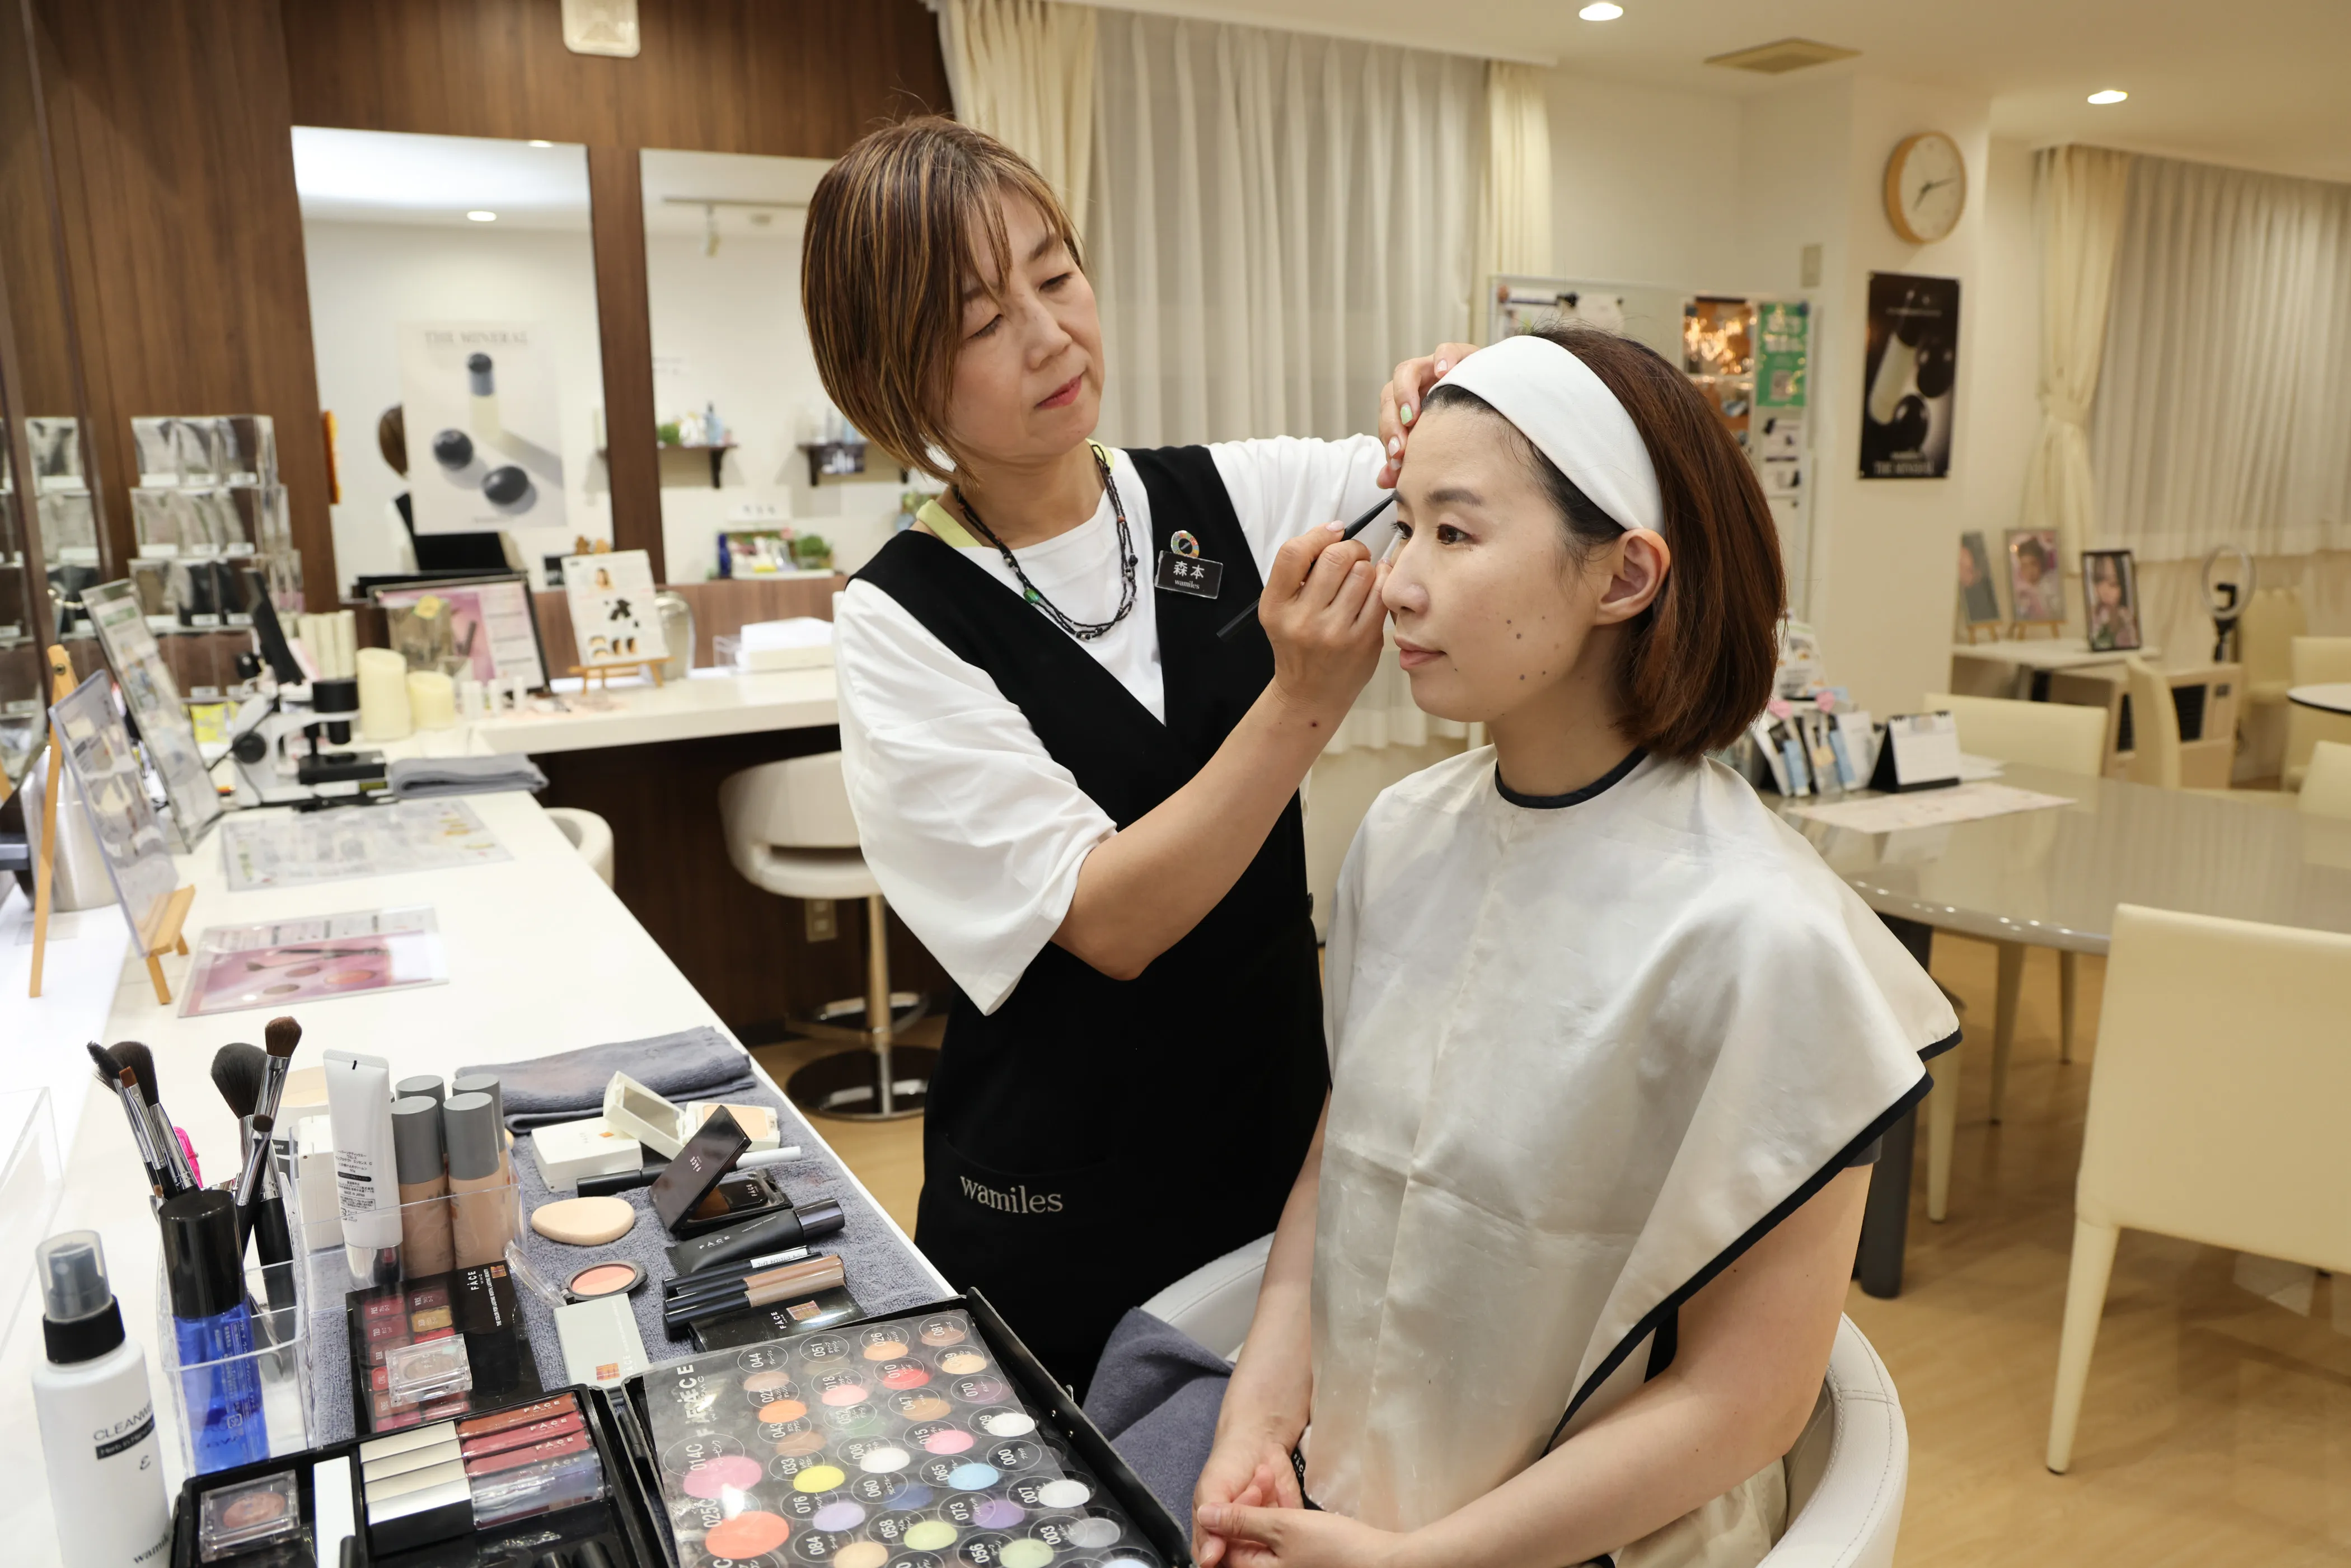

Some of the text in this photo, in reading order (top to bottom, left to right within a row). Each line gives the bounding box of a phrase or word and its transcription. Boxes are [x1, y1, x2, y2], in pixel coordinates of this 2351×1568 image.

[1173, 561, 1205, 579] 森本
[1174, 579, 1200, 589] wamiles
[959, 1176, 1063, 1214] wamiles
[742, 1221, 762, 1233] TREATMENT
[929, 1323, 945, 1336] 081
[870, 1332, 886, 1347] 026
[811, 1342, 826, 1357] 051
[748, 1352, 764, 1368] 044
[884, 1364, 900, 1379] 010
[822, 1376, 837, 1391] 018
[961, 1382, 978, 1397] 070
[759, 1387, 774, 1403] 022
[898, 1397, 916, 1411] 047
[835, 1410, 851, 1424] 052
[979, 1415, 992, 1430] 09
[770, 1422, 786, 1438] 043
[914, 1429, 931, 1444] 015
[685, 1443, 707, 1471] 014C
[849, 1443, 867, 1460] 008
[998, 1449, 1017, 1466] 000
[781, 1457, 798, 1475] 033
[931, 1464, 950, 1481] 065
[863, 1480, 882, 1497] 060
[1018, 1487, 1038, 1504] 007
[699, 1498, 722, 1528] 025C
[793, 1495, 811, 1514] 076
[949, 1502, 969, 1520] 073
[879, 1518, 898, 1538] 058
[1040, 1525, 1061, 1545] 003
[805, 1536, 826, 1555] 084
[968, 1542, 990, 1564] 056
